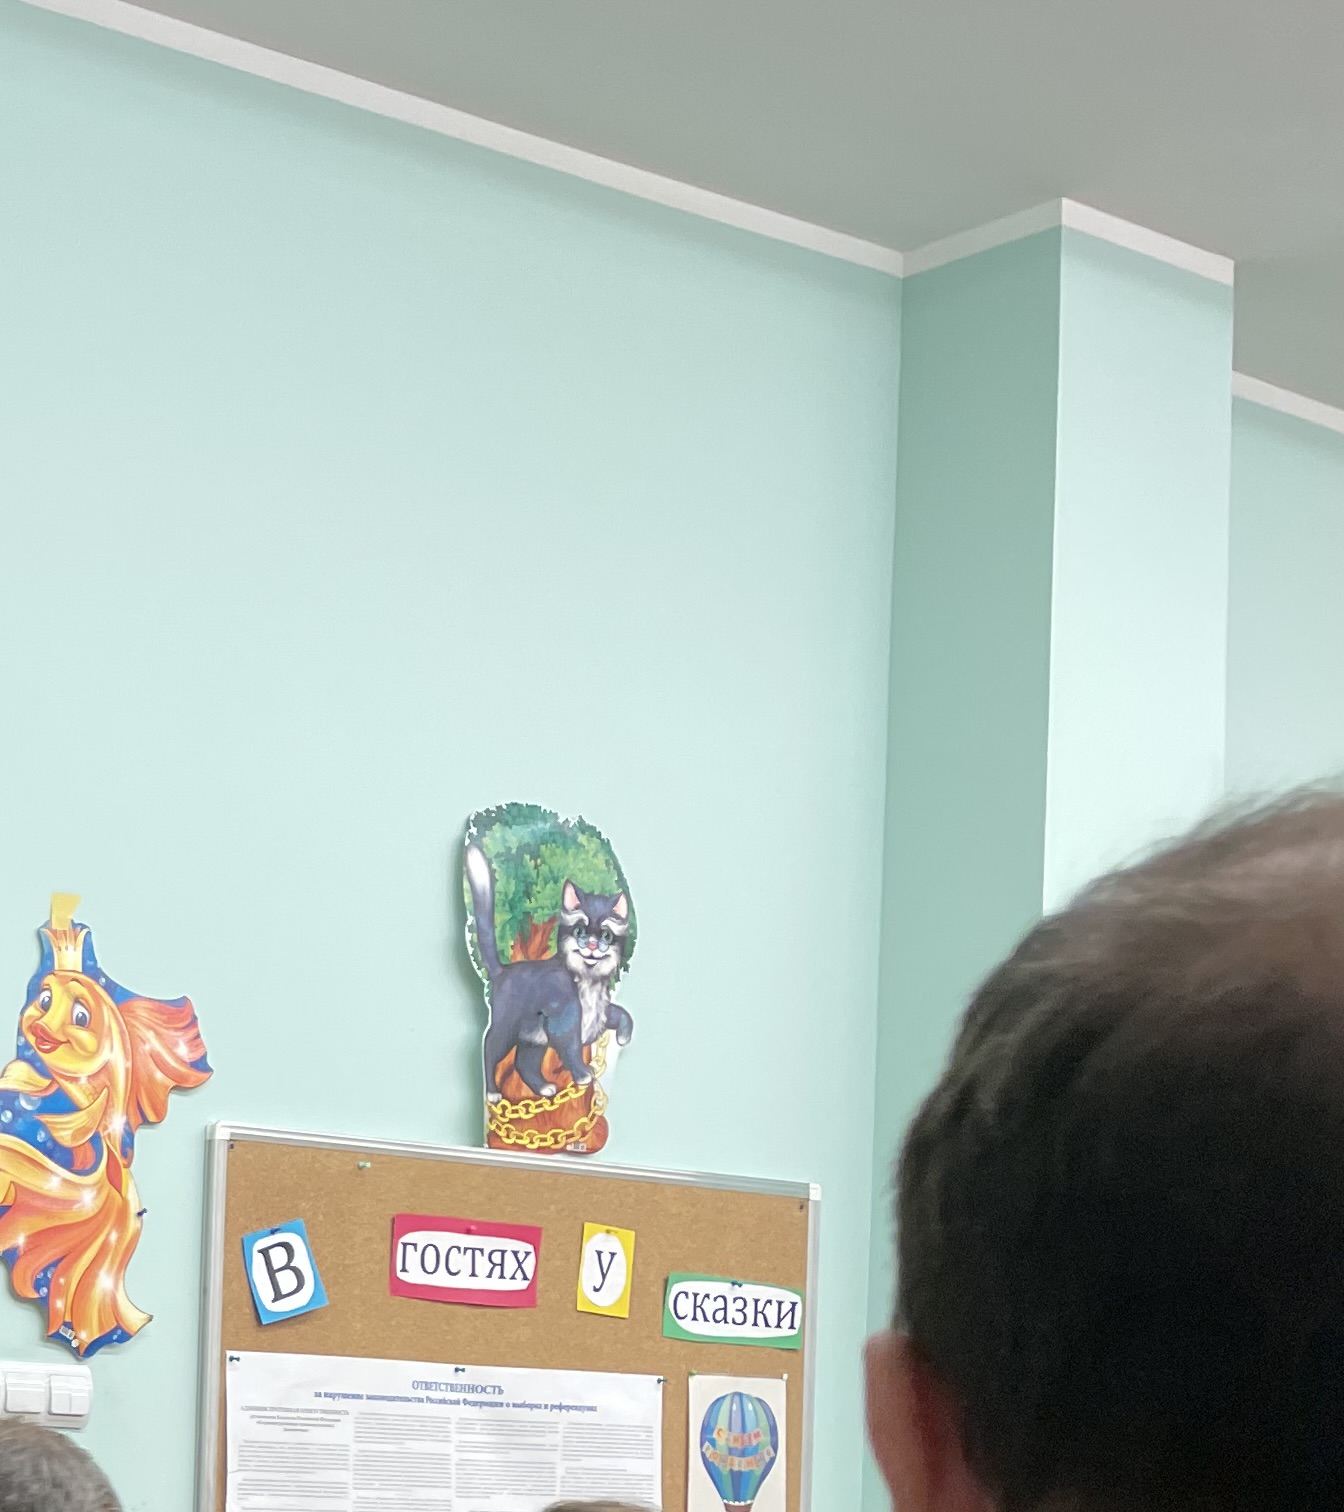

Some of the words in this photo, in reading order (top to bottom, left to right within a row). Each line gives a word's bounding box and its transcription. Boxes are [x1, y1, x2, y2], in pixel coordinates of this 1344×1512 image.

[258, 1240, 307, 1303] В
[672, 1289, 800, 1331] сказки
[412, 1380, 505, 1396] ОТВЕТСТВЕННОСТЬ
